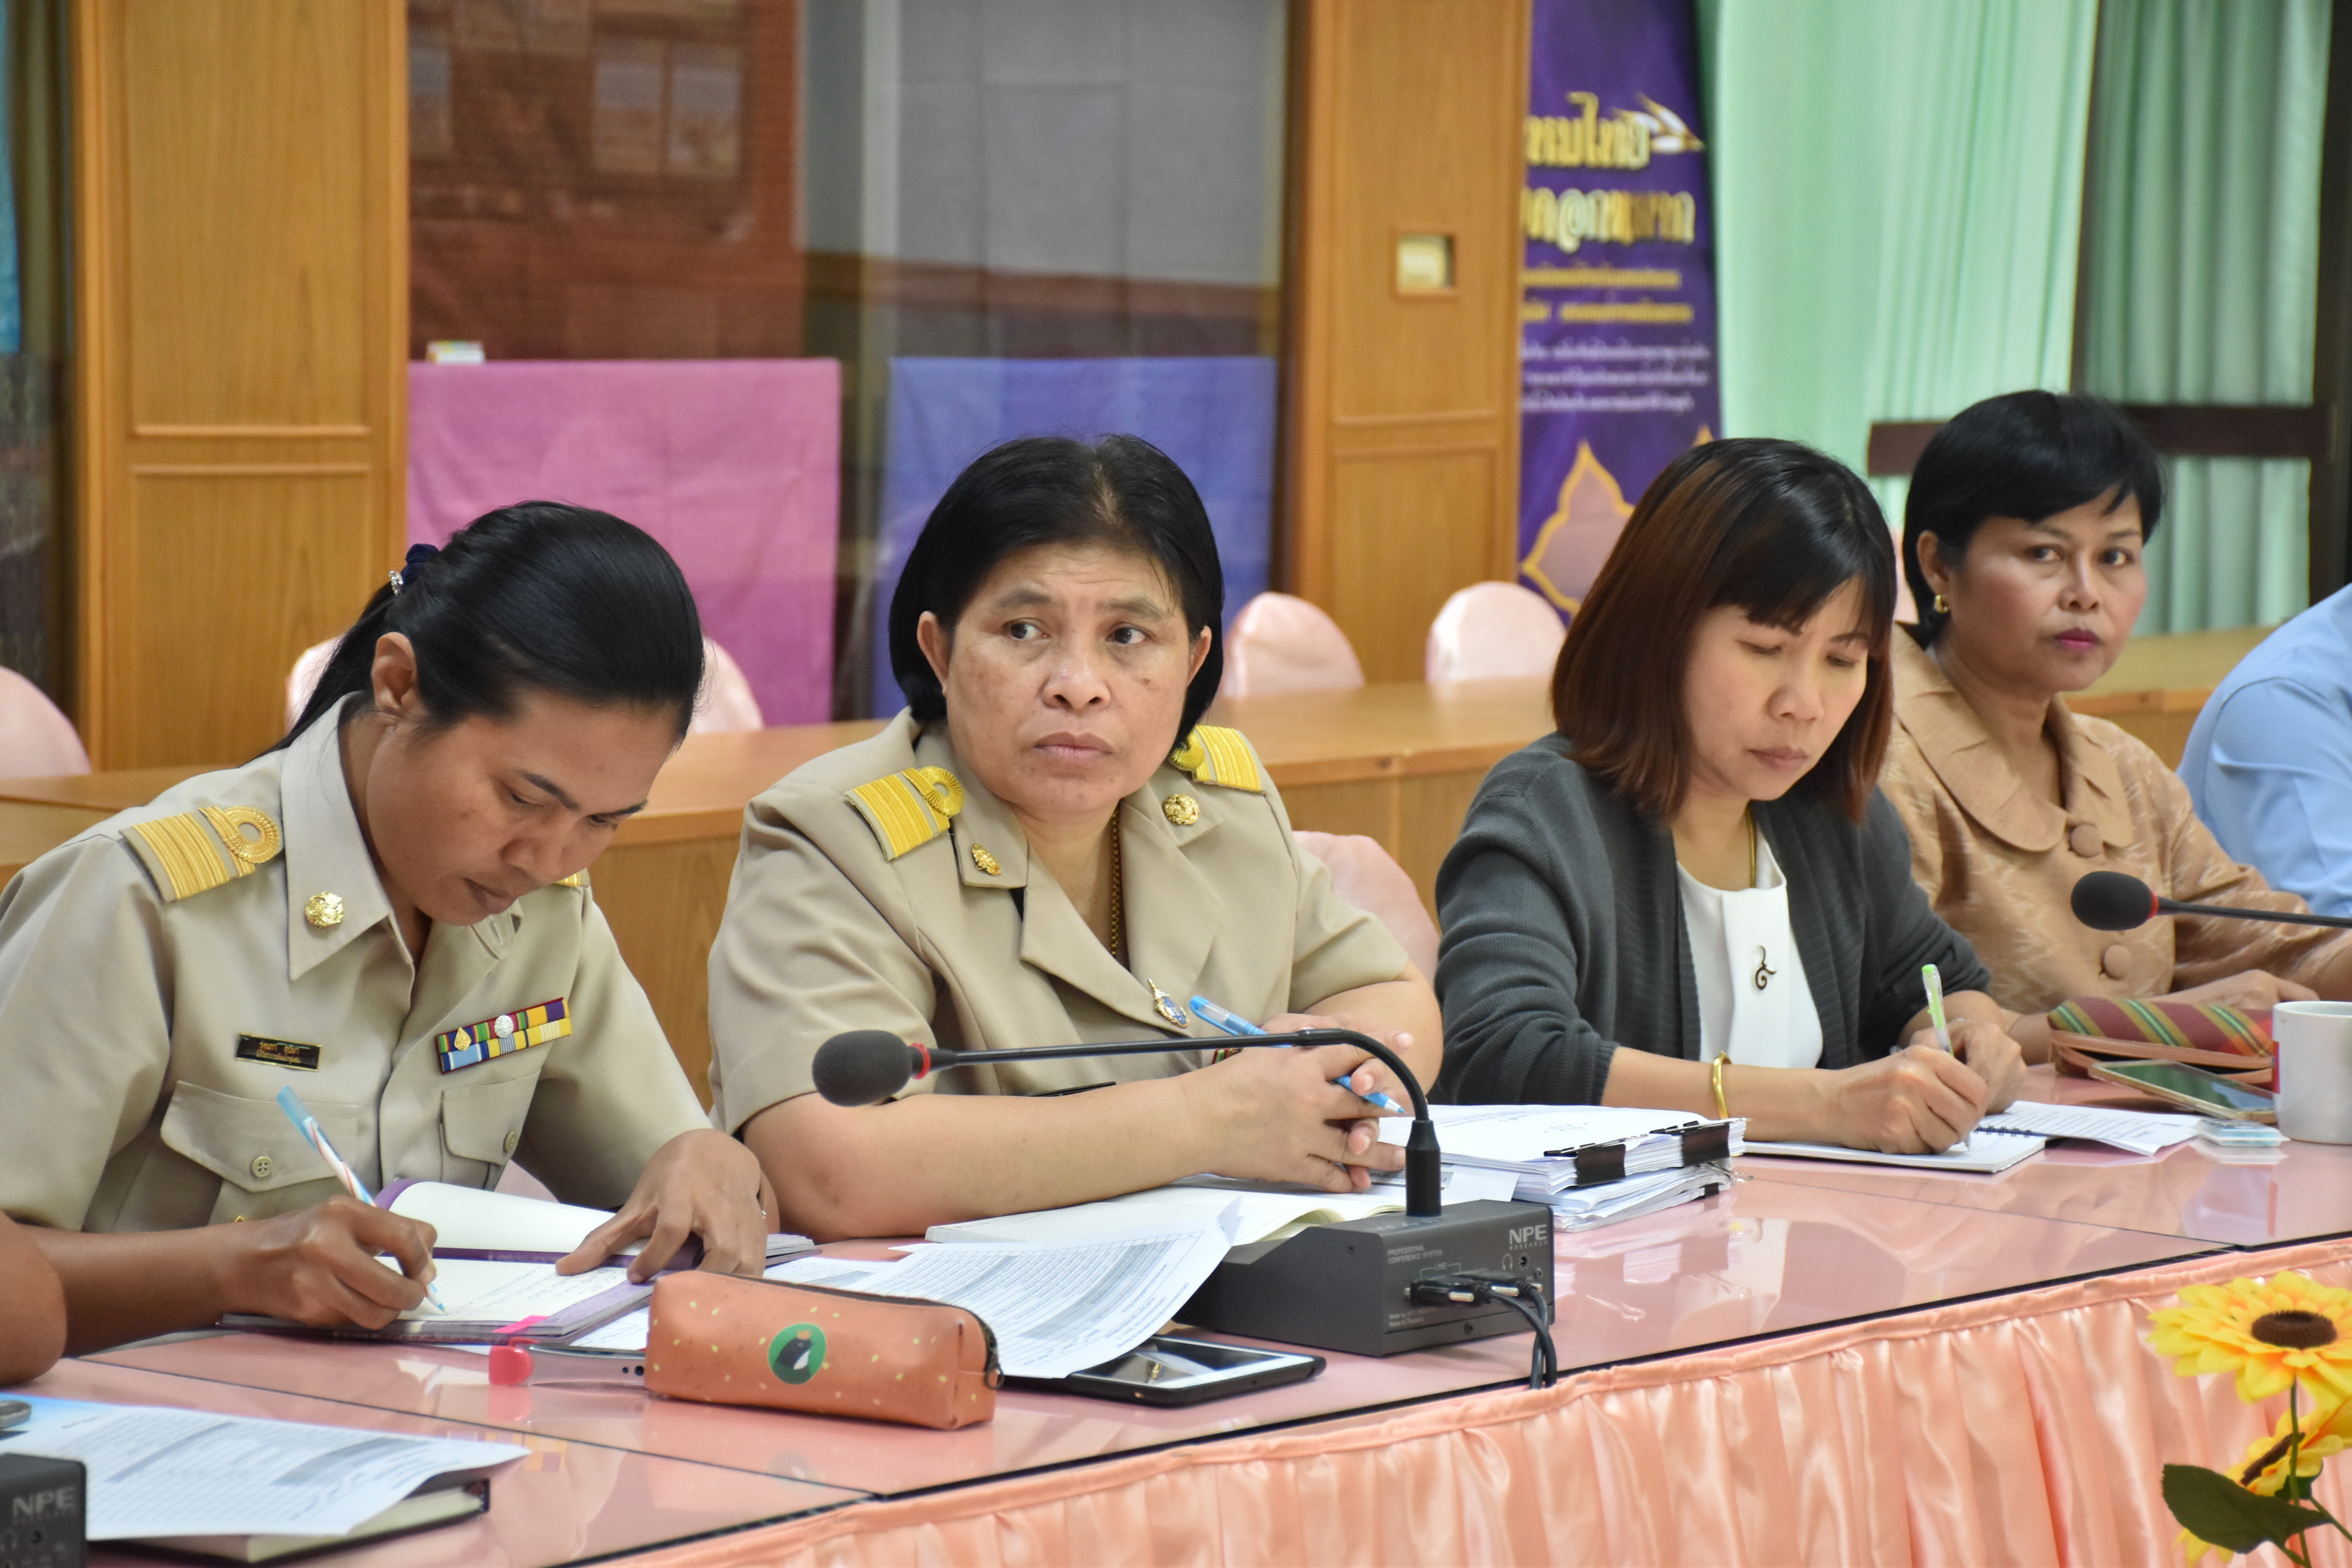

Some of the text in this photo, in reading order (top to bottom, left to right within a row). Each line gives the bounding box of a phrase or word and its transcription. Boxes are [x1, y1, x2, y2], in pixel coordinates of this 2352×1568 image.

[1509, 1224, 1547, 1245] NPE
[1387, 1245, 1425, 1256] PROFESSIONAL
[1388, 1253, 1422, 1264] CONFERENCE
[13, 1487, 75, 1516] NPE
